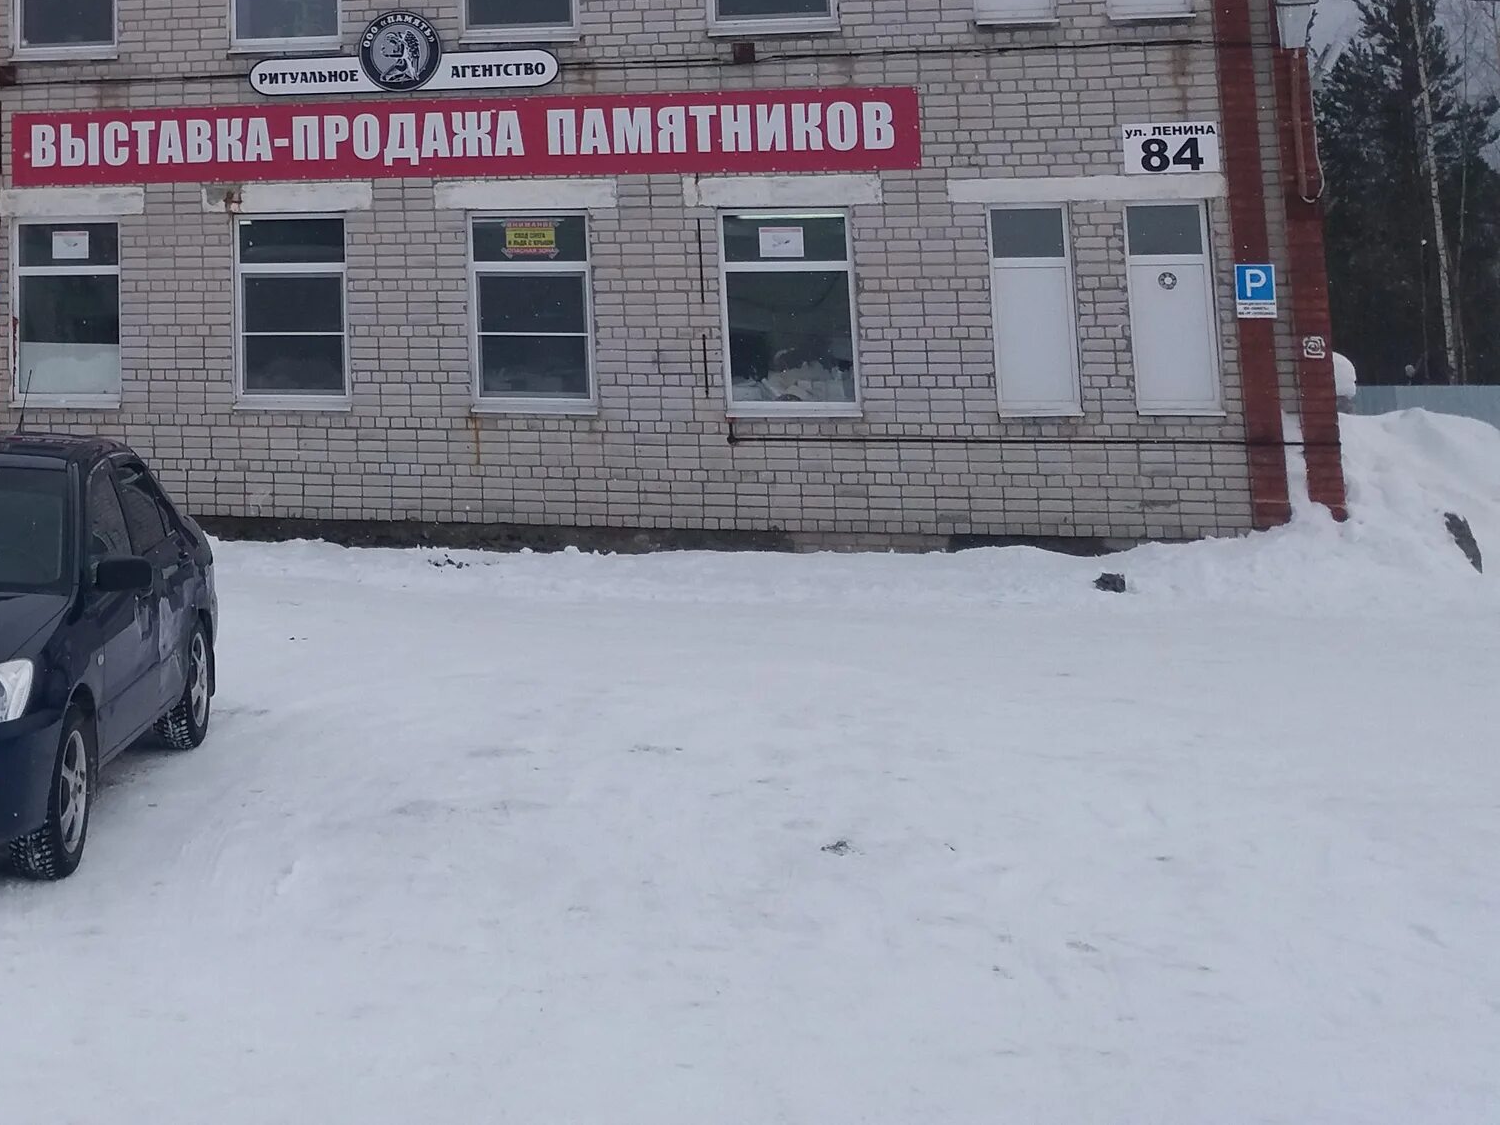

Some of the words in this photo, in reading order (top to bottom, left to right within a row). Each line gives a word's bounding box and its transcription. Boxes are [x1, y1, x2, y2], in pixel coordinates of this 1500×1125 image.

[362, 26, 379, 48] ООО
[380, 14, 436, 43] «ПАМЯТЬ»
[258, 69, 359, 85] РИТУАЛЬНОЕ
[450, 62, 547, 79] АГЕНТСТВО
[30, 109, 525, 168] ВЫСТАВКА-ПРОДАЖА
[546, 101, 895, 156] ПАМЯТНИКОВ
[1125, 129, 1147, 139] ул.
[1151, 124, 1216, 136] ЛЕНИНА
[1141, 137, 1204, 172] 84
